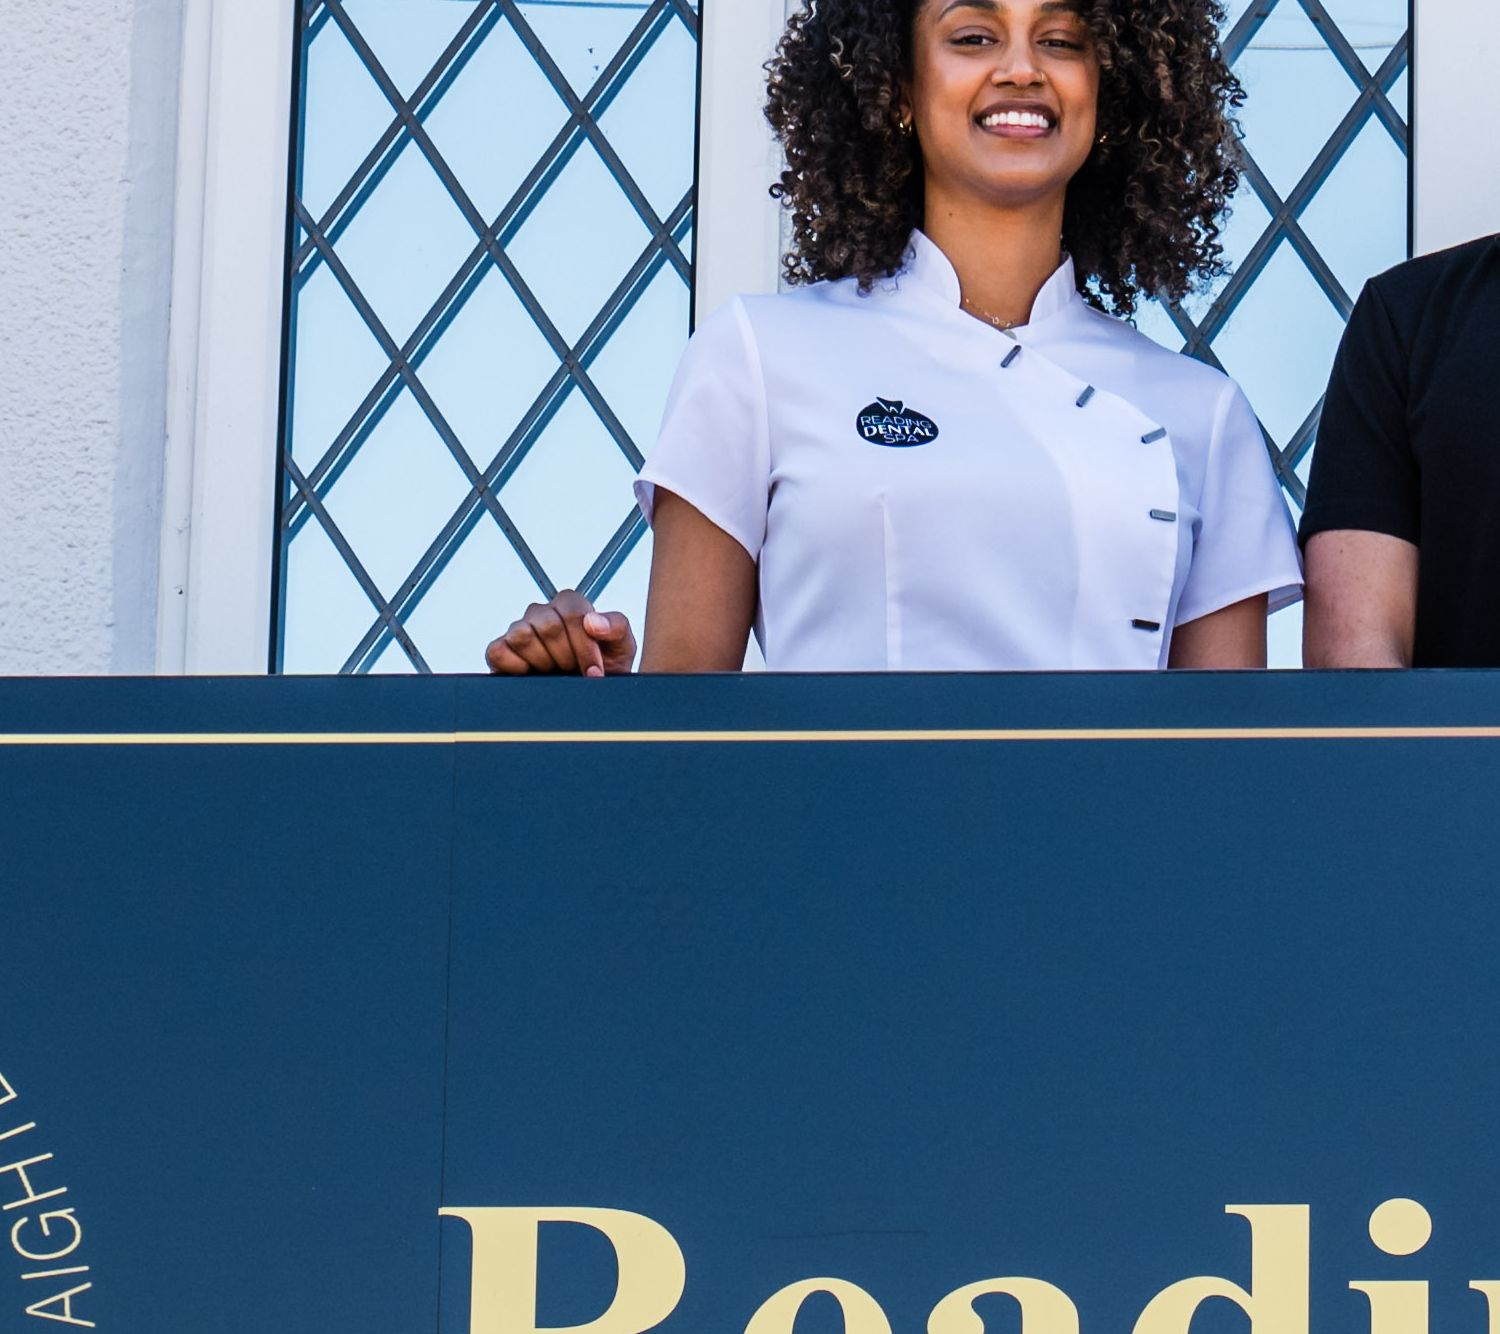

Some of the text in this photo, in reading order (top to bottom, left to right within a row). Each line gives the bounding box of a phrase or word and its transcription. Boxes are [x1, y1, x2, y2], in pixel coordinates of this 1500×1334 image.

[860, 415, 932, 428] READING
[863, 424, 934, 437] DENTAL
[884, 434, 919, 443] SPA
